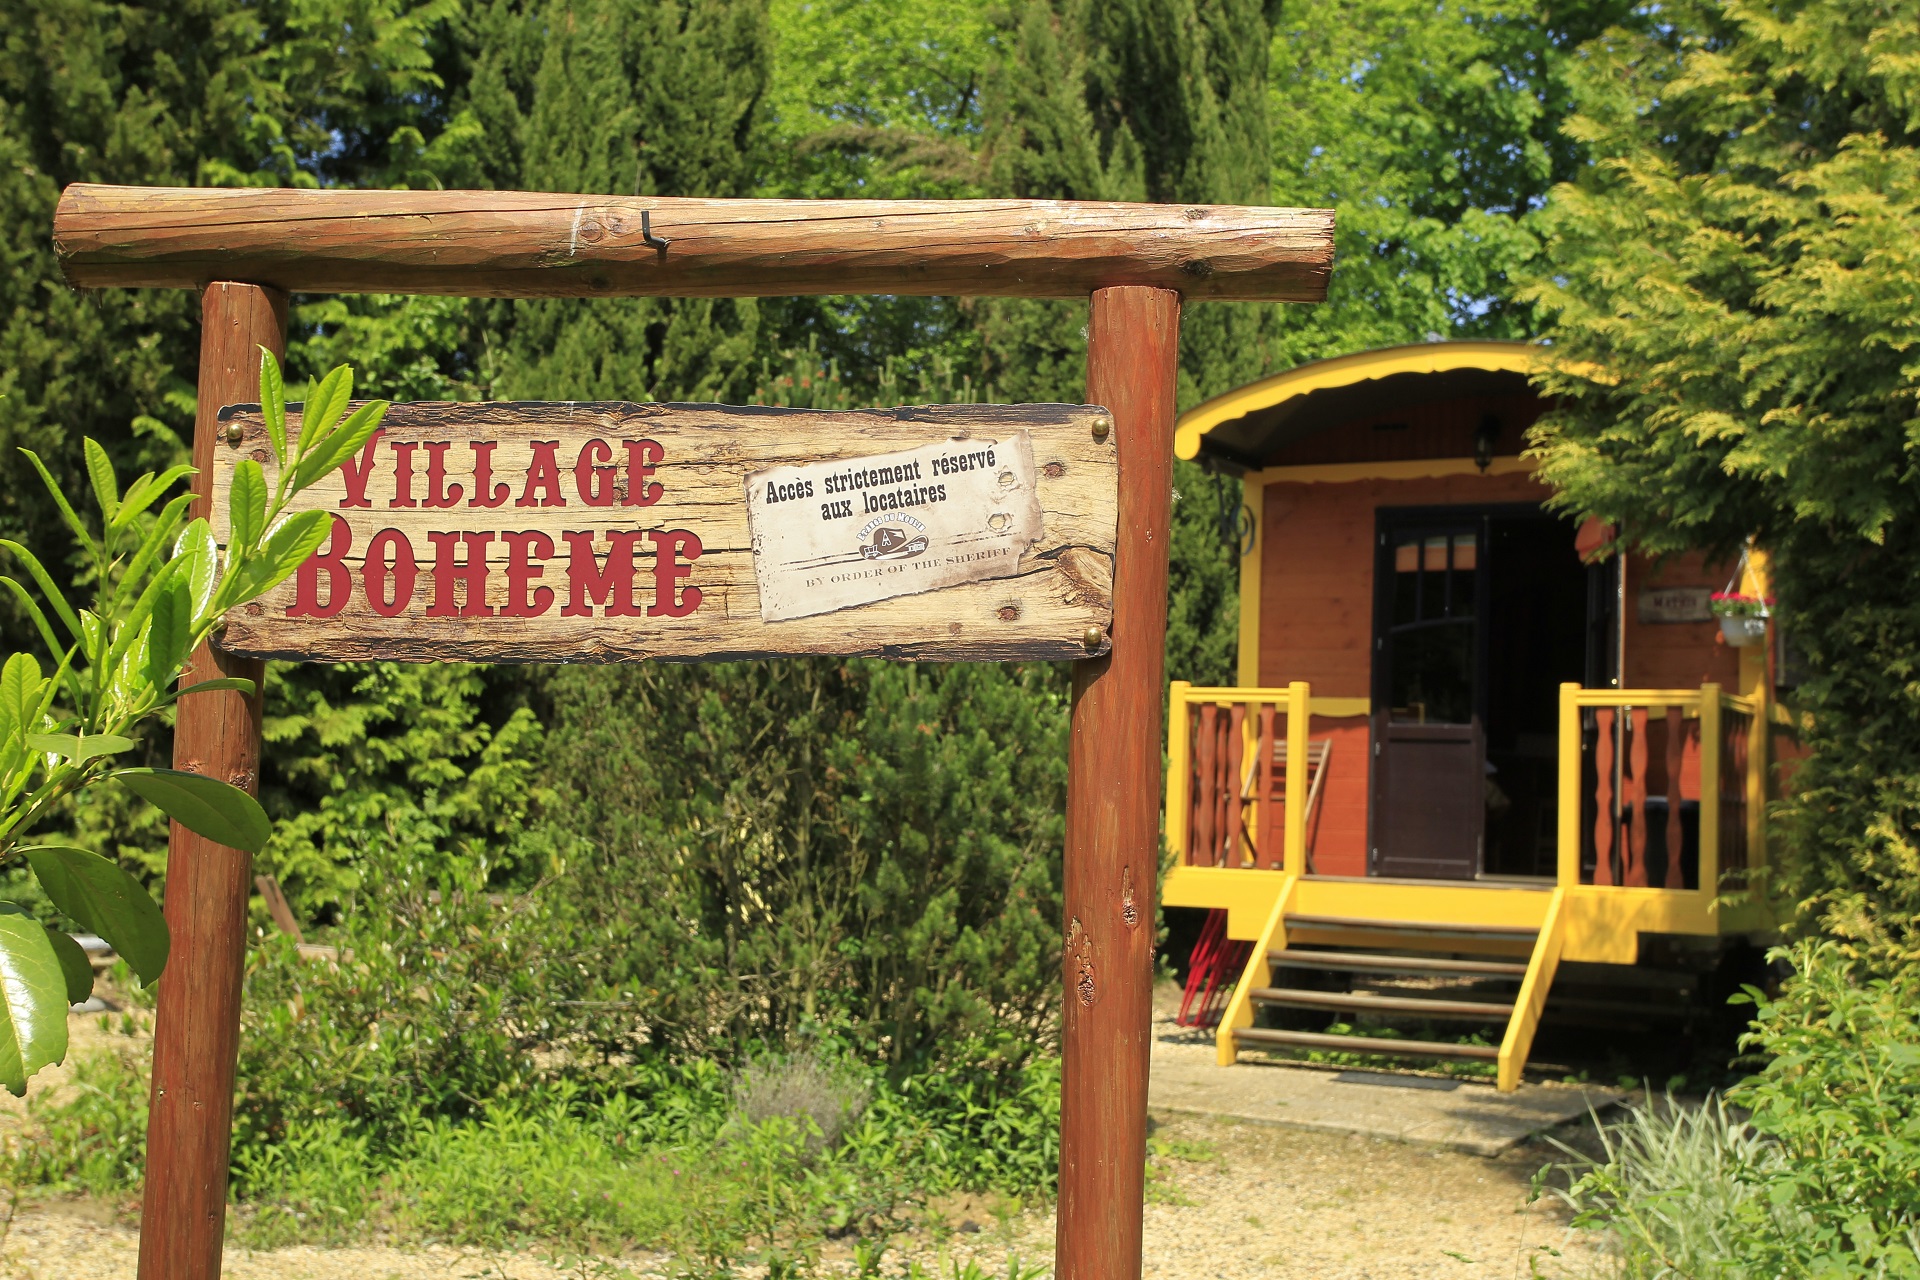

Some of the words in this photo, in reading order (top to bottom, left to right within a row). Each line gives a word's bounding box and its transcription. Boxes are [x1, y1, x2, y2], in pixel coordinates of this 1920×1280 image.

[338, 427, 665, 507] VILLAGE
[765, 477, 814, 504] Accès
[824, 458, 922, 494] strictement
[931, 445, 996, 476] réservé
[821, 498, 853, 521] aux
[863, 483, 947, 514] locataires
[285, 511, 703, 618] BOHEME
[806, 577, 825, 588] BY
[830, 567, 884, 584] ORDER
[887, 563, 908, 574] OF
[912, 558, 941, 570] THE
[945, 546, 1012, 565] SHERIFF
